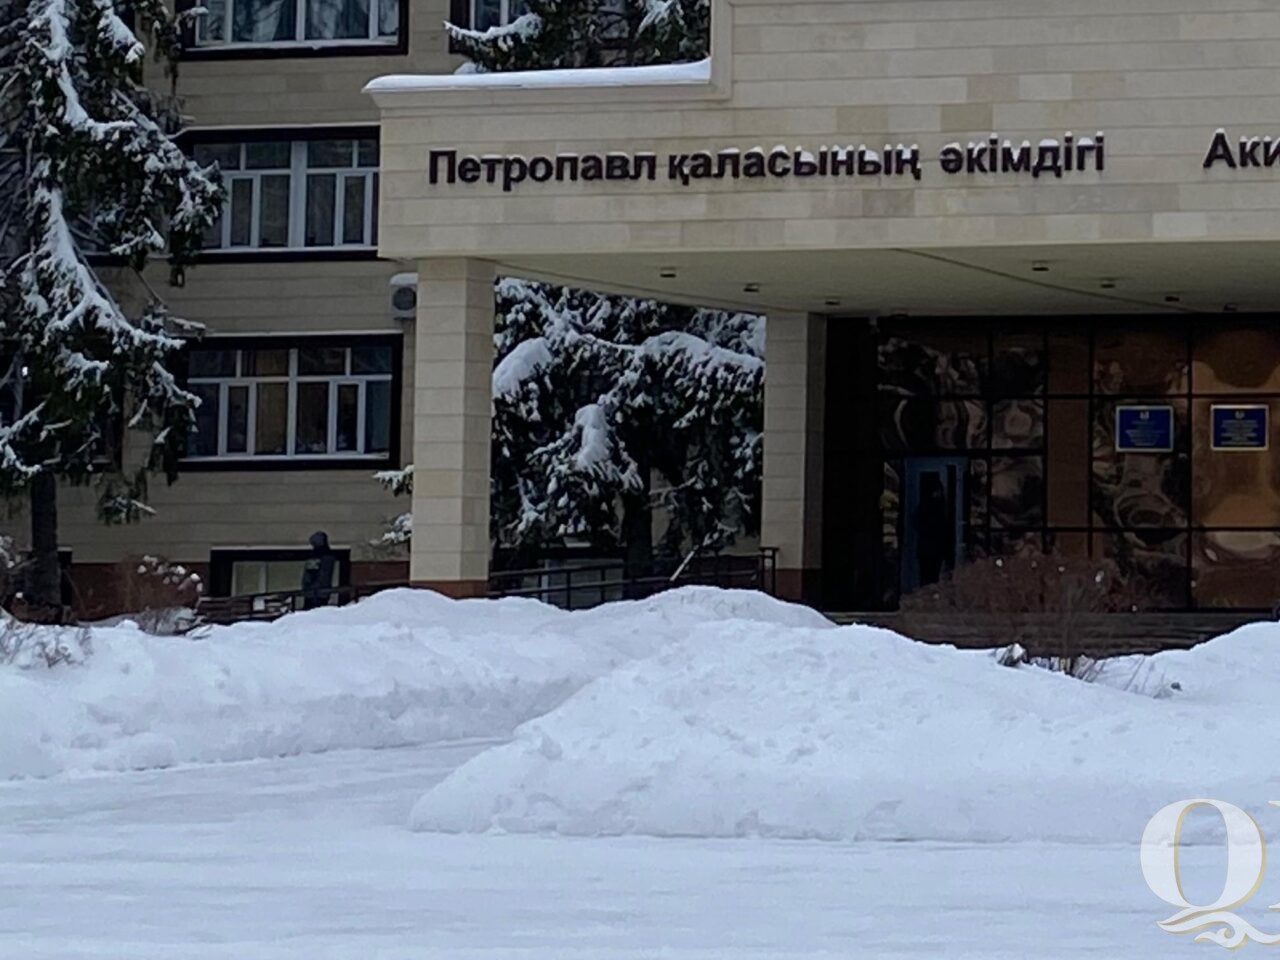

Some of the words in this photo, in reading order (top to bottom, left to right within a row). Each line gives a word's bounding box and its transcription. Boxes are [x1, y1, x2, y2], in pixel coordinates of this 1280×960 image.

[428, 147, 657, 191] Петропавл
[668, 144, 922, 186] қаласының
[940, 132, 1105, 178] әкімдігі
